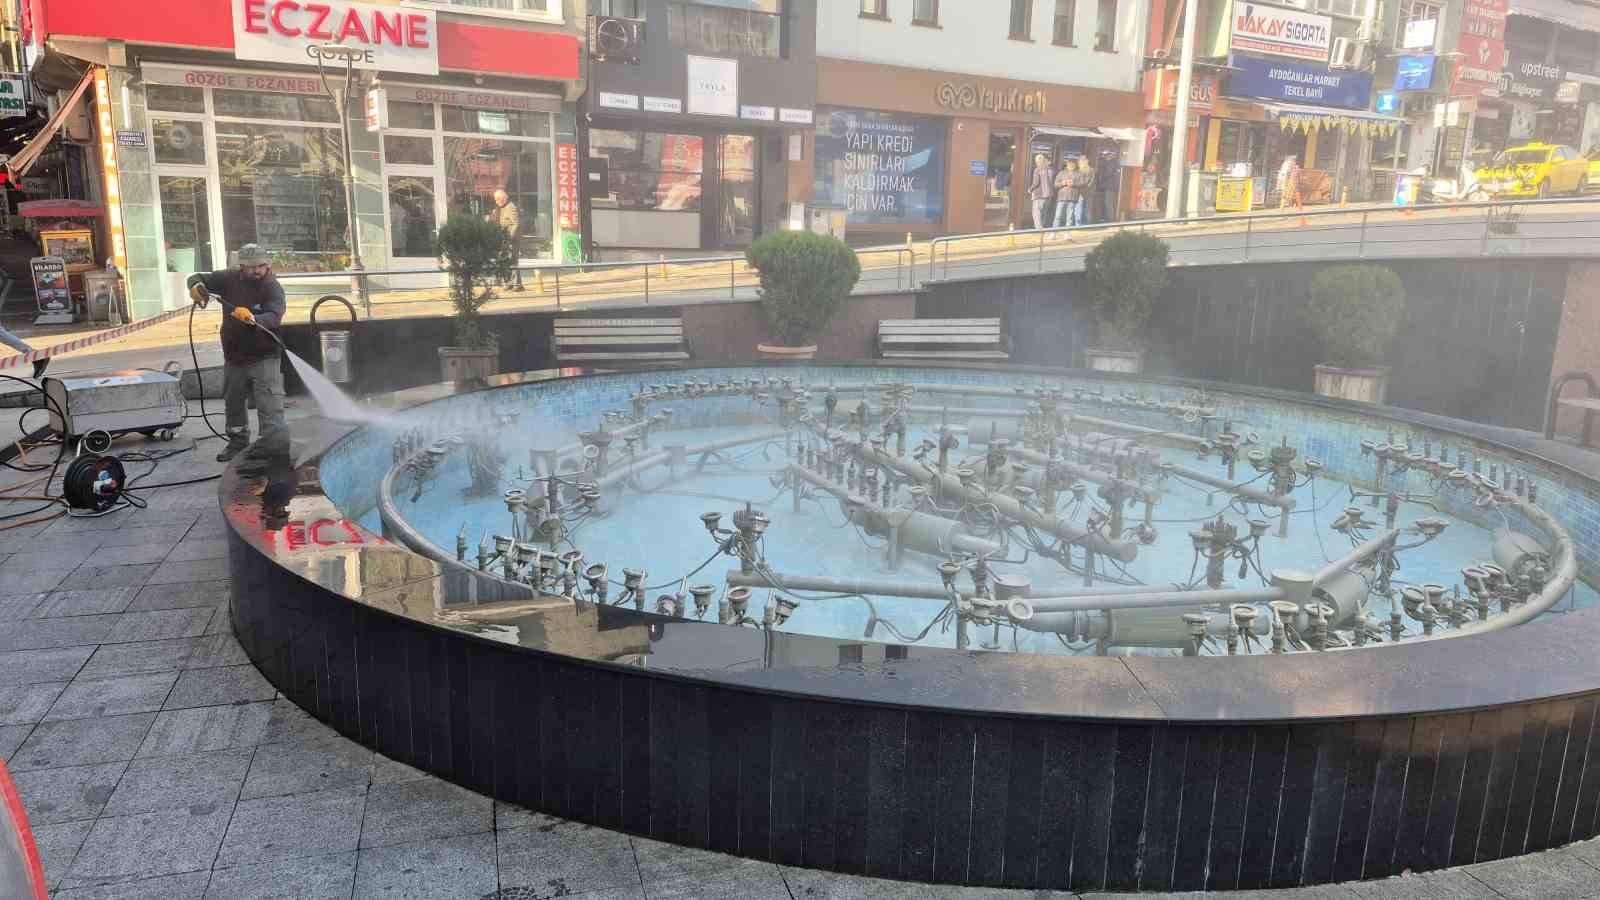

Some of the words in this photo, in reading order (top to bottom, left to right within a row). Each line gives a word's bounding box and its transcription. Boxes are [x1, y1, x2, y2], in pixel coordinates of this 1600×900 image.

[244, 0, 430, 49] ECZANE
[1284, 84, 1304, 97] TEKEL
[1314, 73, 1340, 88] MARKET
[846, 131, 873, 150] YAPI
[877, 134, 913, 153] KREDİ
[844, 151, 905, 173] SINIRLARI
[559, 147, 569, 225] ECZANE
[844, 173, 914, 193] KALDIRMAK
